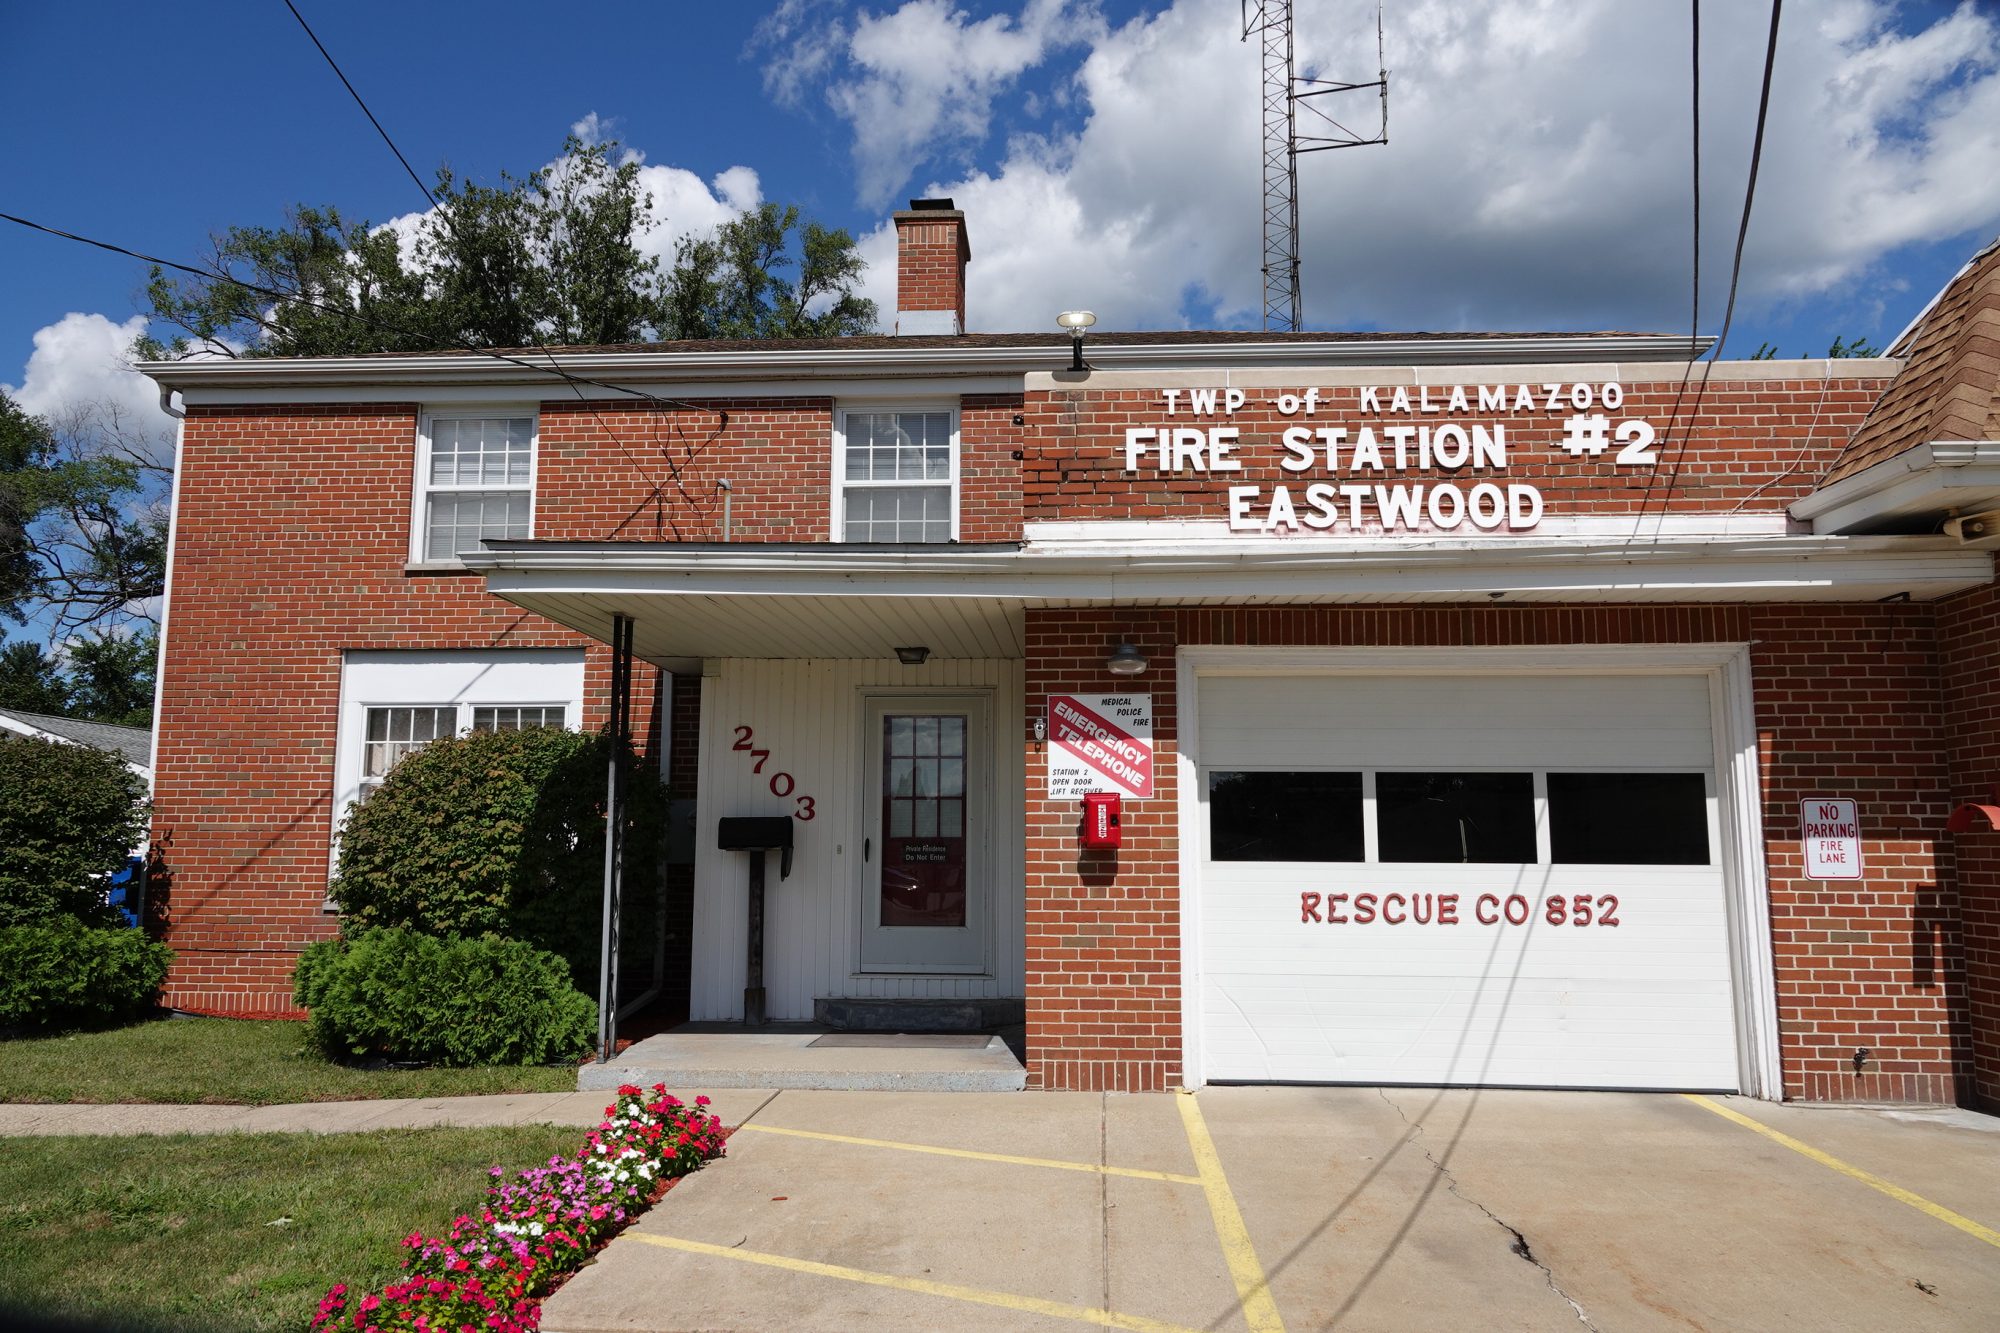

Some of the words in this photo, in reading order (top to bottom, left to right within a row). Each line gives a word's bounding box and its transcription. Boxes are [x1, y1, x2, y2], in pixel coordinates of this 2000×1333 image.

[1163, 389, 1246, 415] TWP
[1277, 387, 1319, 414] of
[1360, 382, 1624, 413] KALAMAZOO
[1125, 427, 1242, 471] FIRE
[1280, 424, 1506, 471] STATION
[1561, 414, 1657, 465] #2
[1229, 484, 1543, 531] EASTWOOD
[1101, 698, 1131, 706] MEDICAL
[1116, 708, 1142, 716] POLICE
[1133, 718, 1149, 726] FIRE
[1053, 701, 1147, 765] EMERGENCY
[1058, 724, 1145, 788] TELEPHONE
[1819, 805, 1839, 820] NO
[1807, 823, 1855, 838] PARKING
[1820, 841, 1843, 851] FIRE
[1820, 853, 1846, 863] LANE
[1301, 892, 1459, 925] RESCUE
[1475, 893, 1529, 926] CO
[1546, 894, 1620, 927] 852
